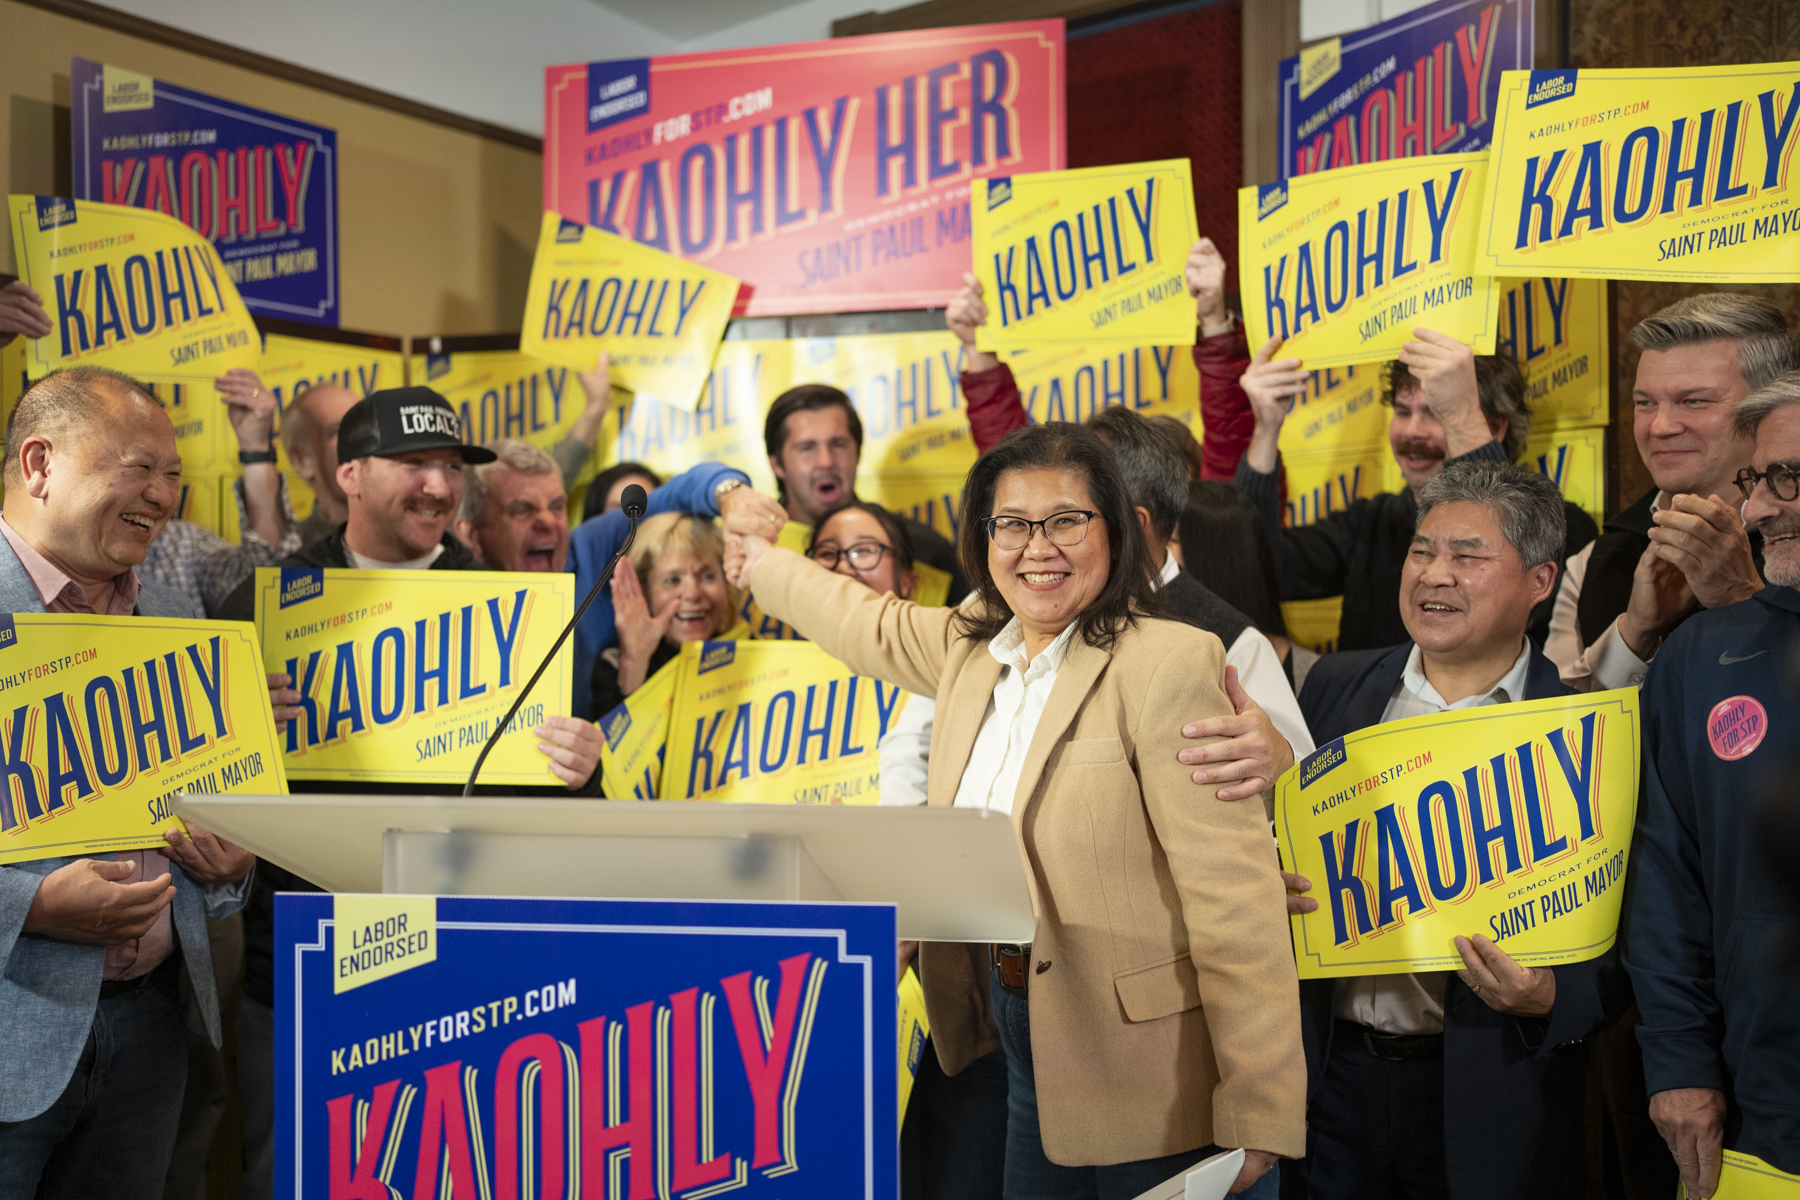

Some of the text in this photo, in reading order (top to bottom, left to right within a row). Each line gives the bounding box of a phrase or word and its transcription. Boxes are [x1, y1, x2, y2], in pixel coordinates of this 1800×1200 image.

[1528, 82, 1574, 105] ENDORSED
[1536, 76, 1565, 94] LABOR
[584, 86, 773, 166] KAOHLYFORSTP.COM
[1529, 99, 1650, 140] KAOHLYFORSTP.COM
[587, 49, 1023, 264] KAOHLY HER
[1514, 75, 1800, 255] KAOHLY
[1656, 206, 1800, 262] SAINT PAUL MAYO
[1682, 198, 1789, 229] DEMOCRAT FOR
[798, 234, 864, 289] SAINT
[871, 217, 930, 267] PAUL
[994, 177, 1161, 332] KAOHLY
[1264, 168, 1472, 346] KAOHLY
[54, 244, 231, 361] KAOHLY
[542, 276, 712, 343] KAOHLY
[1358, 276, 1473, 344] SAINT PAUL MAYOR
[170, 341, 201, 368] SAINT
[460, 367, 567, 447] AOHLY
[846, 345, 965, 440] OHLY
[401, 413, 454, 435] LOCAL
[281, 582, 321, 604] ENDORSED
[287, 575, 313, 591] LABOR
[285, 601, 393, 641] KAOHLYFORSTP.COM
[0, 647, 98, 692] OHLYFORSTP.COM
[285, 589, 537, 758] KAOHLY
[0, 635, 236, 836] KAOHLY
[416, 703, 544, 763] SAINT PAUL MAYOR
[434, 705, 496, 728] DEMOCRAT
[686, 675, 910, 800] KAOHLY
[1712, 702, 1745, 741] KAOHLY
[1722, 714, 1758, 754] FOR STP
[162, 747, 242, 786] DEMOCRAT FOR
[221, 752, 264, 790] MAYOR
[1301, 750, 1343, 785] ENDORSED
[1306, 748, 1333, 773] LABOR
[1312, 750, 1433, 816] KAOHLYFORSTP.COM
[1318, 711, 1606, 950] KAOHLY
[1489, 849, 1625, 943] SAINT PAUL MAYOR
[1507, 847, 1609, 899] DEMOCRAT FOR
[340, 930, 428, 978] ENDORSED
[353, 913, 408, 950] LABOR
[331, 978, 577, 1076] KAOHLYFORSTP.COM
[327, 952, 828, 1200] KAOHLY
